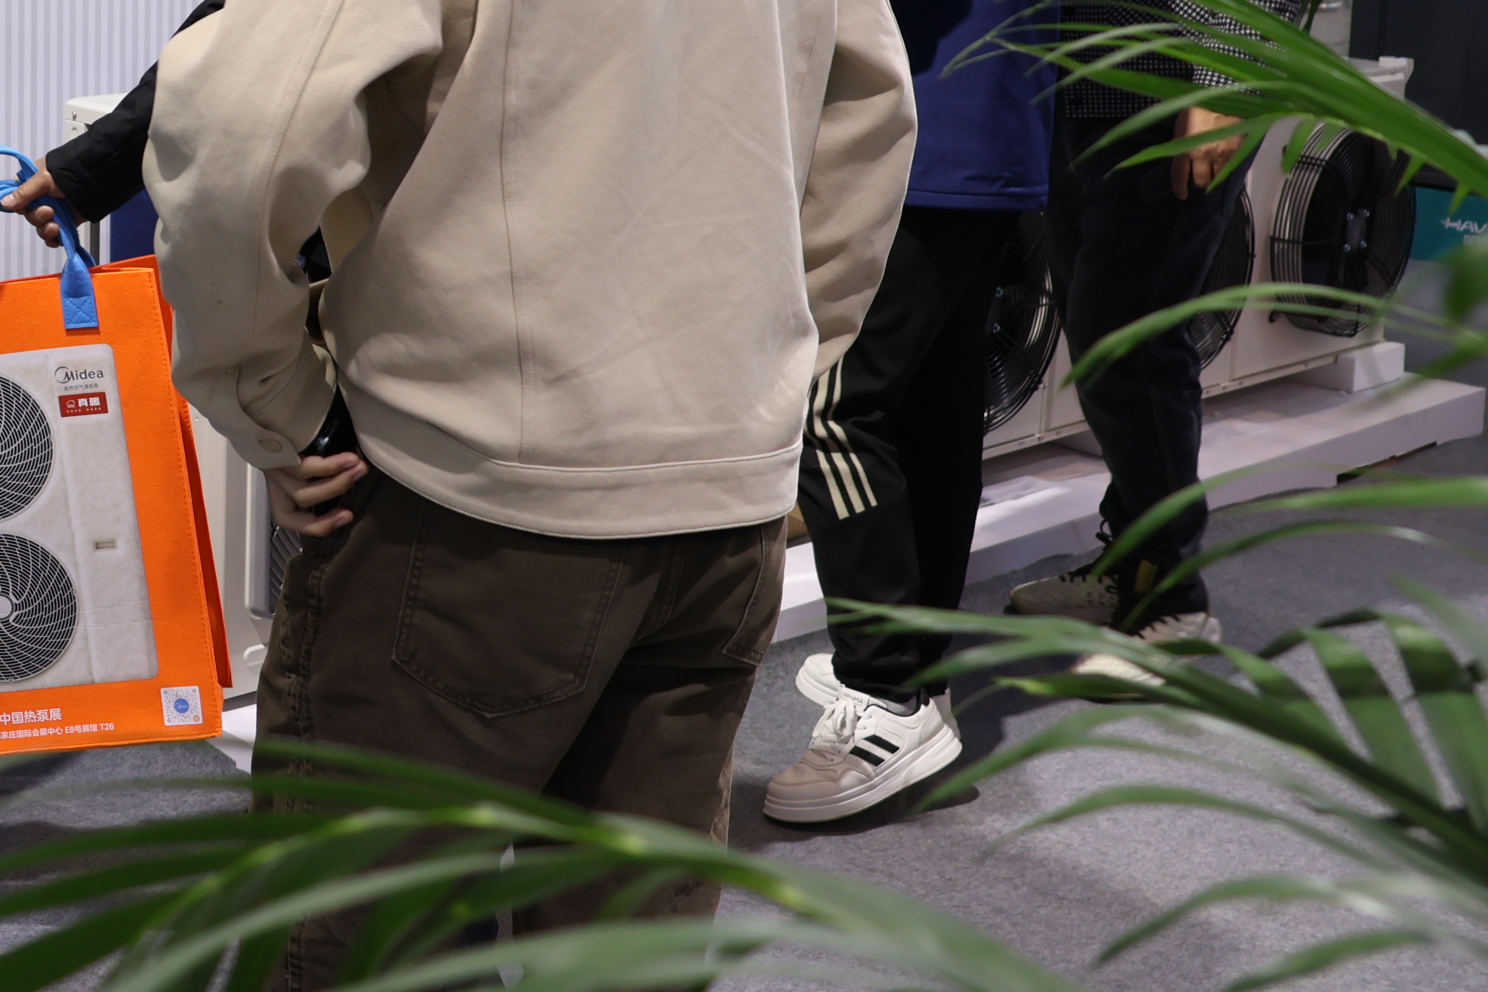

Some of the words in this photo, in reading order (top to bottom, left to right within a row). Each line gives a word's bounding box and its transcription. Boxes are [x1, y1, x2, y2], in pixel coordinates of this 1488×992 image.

[55, 366, 104, 384] Midea
[65, 723, 98, 734] E8号展馆
[99, 722, 115, 731] T26
